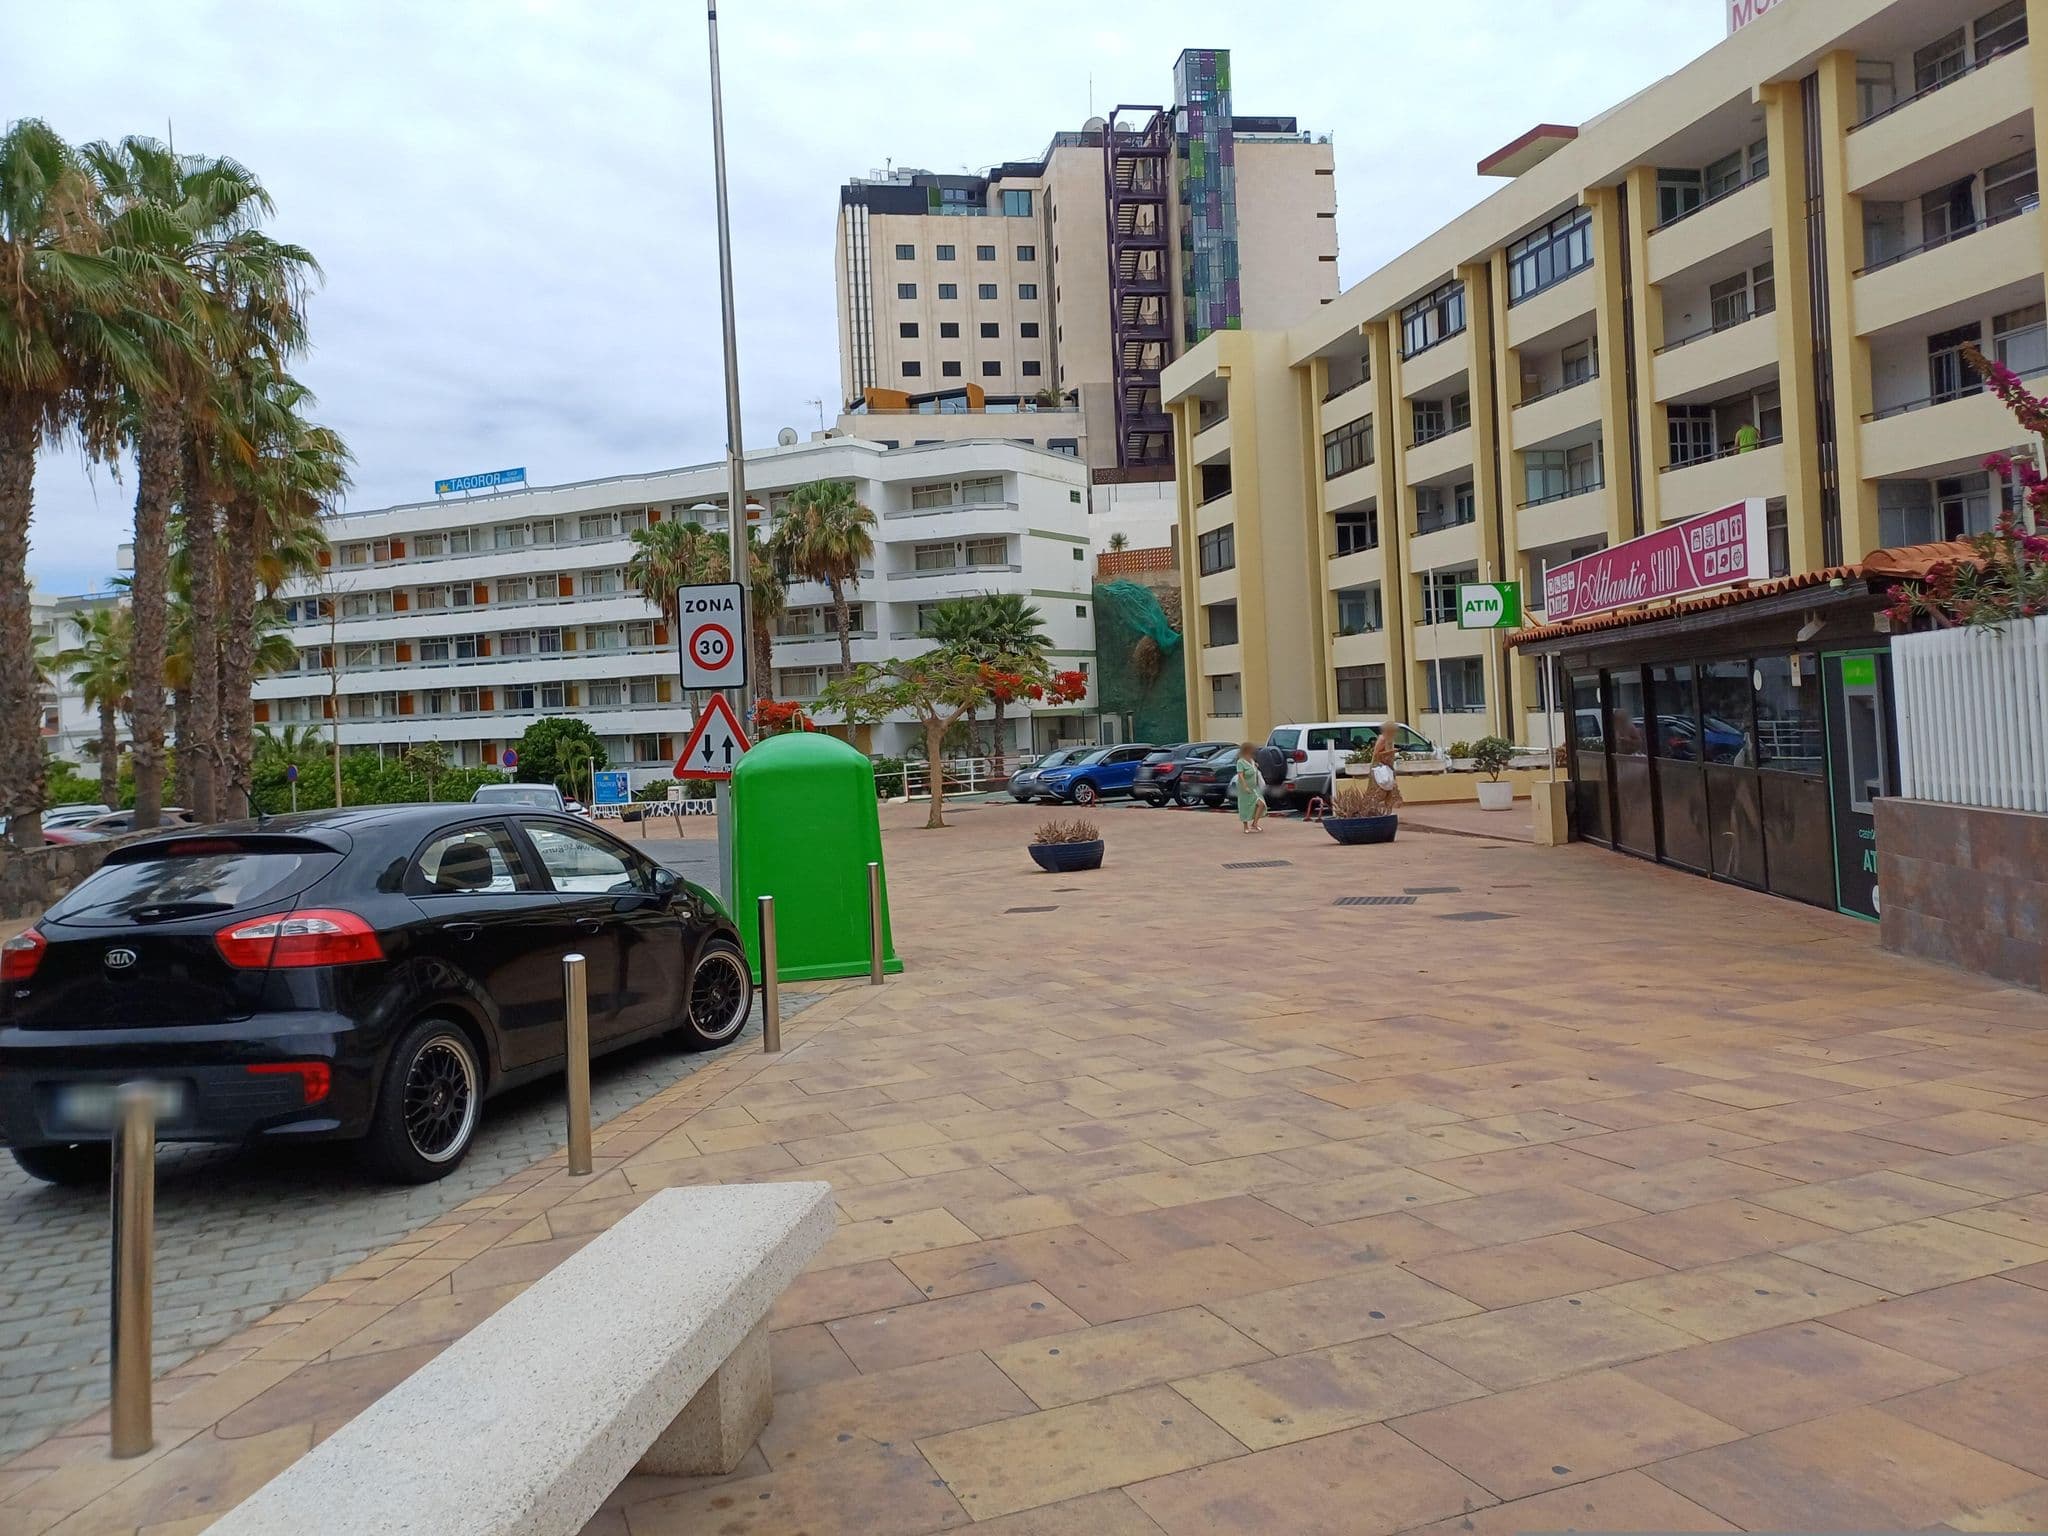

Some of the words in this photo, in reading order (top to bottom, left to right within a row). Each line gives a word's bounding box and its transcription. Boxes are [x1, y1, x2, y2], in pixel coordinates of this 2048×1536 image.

[451, 473, 500, 490] TAGOROR
[1580, 558, 1647, 609] Atlantic
[1651, 545, 1680, 593] SHOP
[685, 598, 734, 613] ZONA
[1464, 599, 1499, 613] ATM
[699, 639, 724, 655] 30
[108, 953, 130, 965] KIA
